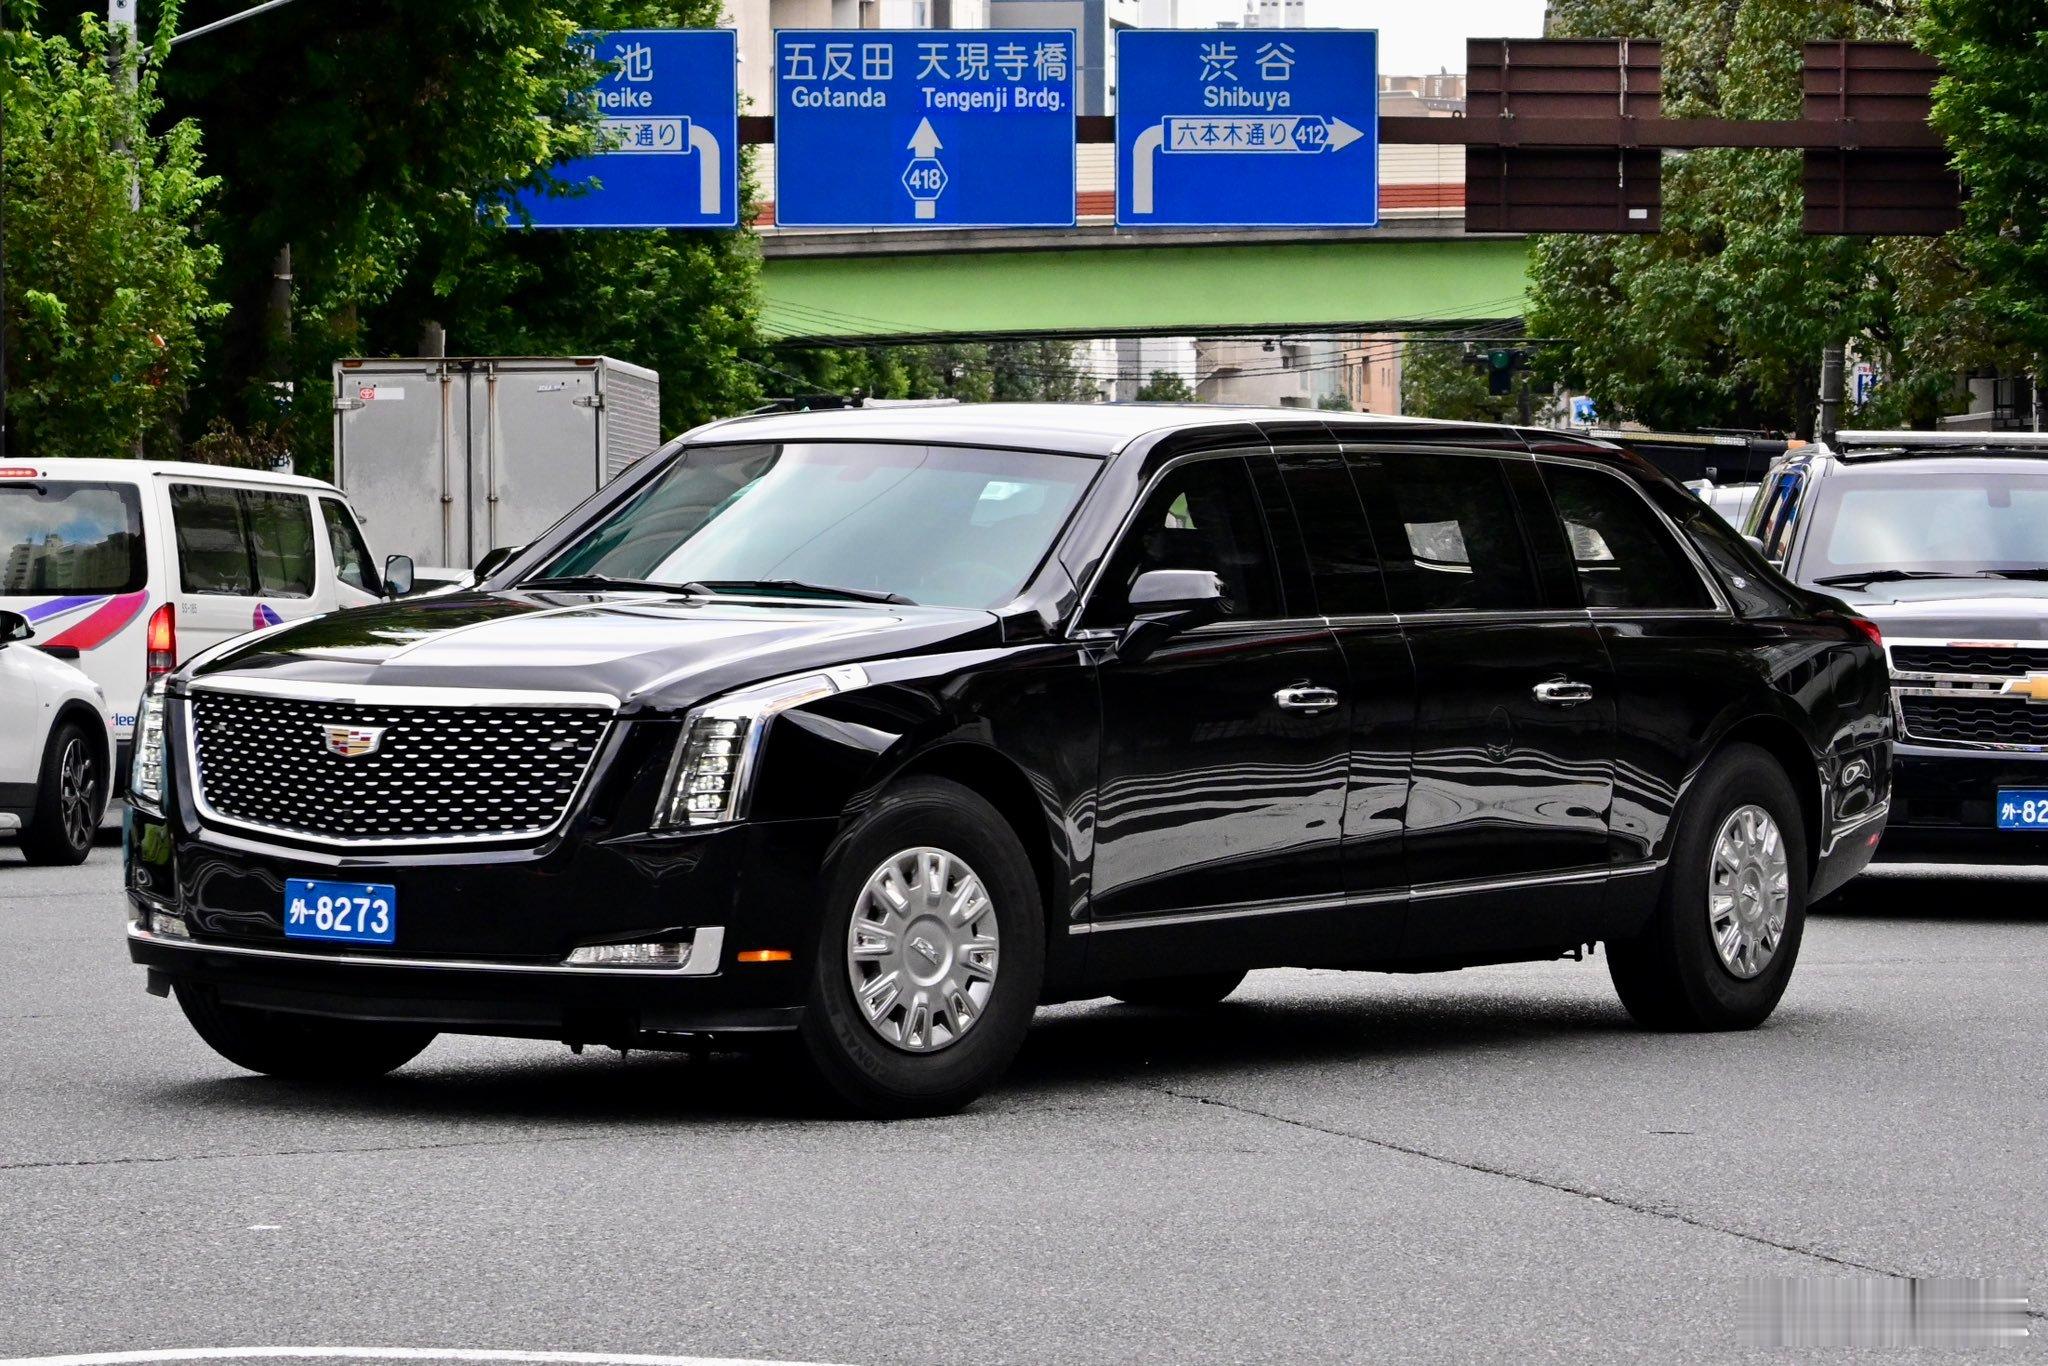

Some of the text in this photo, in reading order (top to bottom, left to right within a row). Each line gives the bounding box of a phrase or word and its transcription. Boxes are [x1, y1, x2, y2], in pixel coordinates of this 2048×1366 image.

[783, 42, 1067, 82] 五反田 天現寺橋
[1199, 41, 1296, 82] 渋谷
[791, 86, 887, 108] Gotanda
[921, 87, 1066, 112] Tengenji Brdg.
[1203, 85, 1291, 111] Shibuya
[1177, 122, 1287, 147] 六本木通り
[1294, 125, 1325, 145] 412
[908, 168, 942, 190] 418
[289, 895, 389, 934] 外-8273
